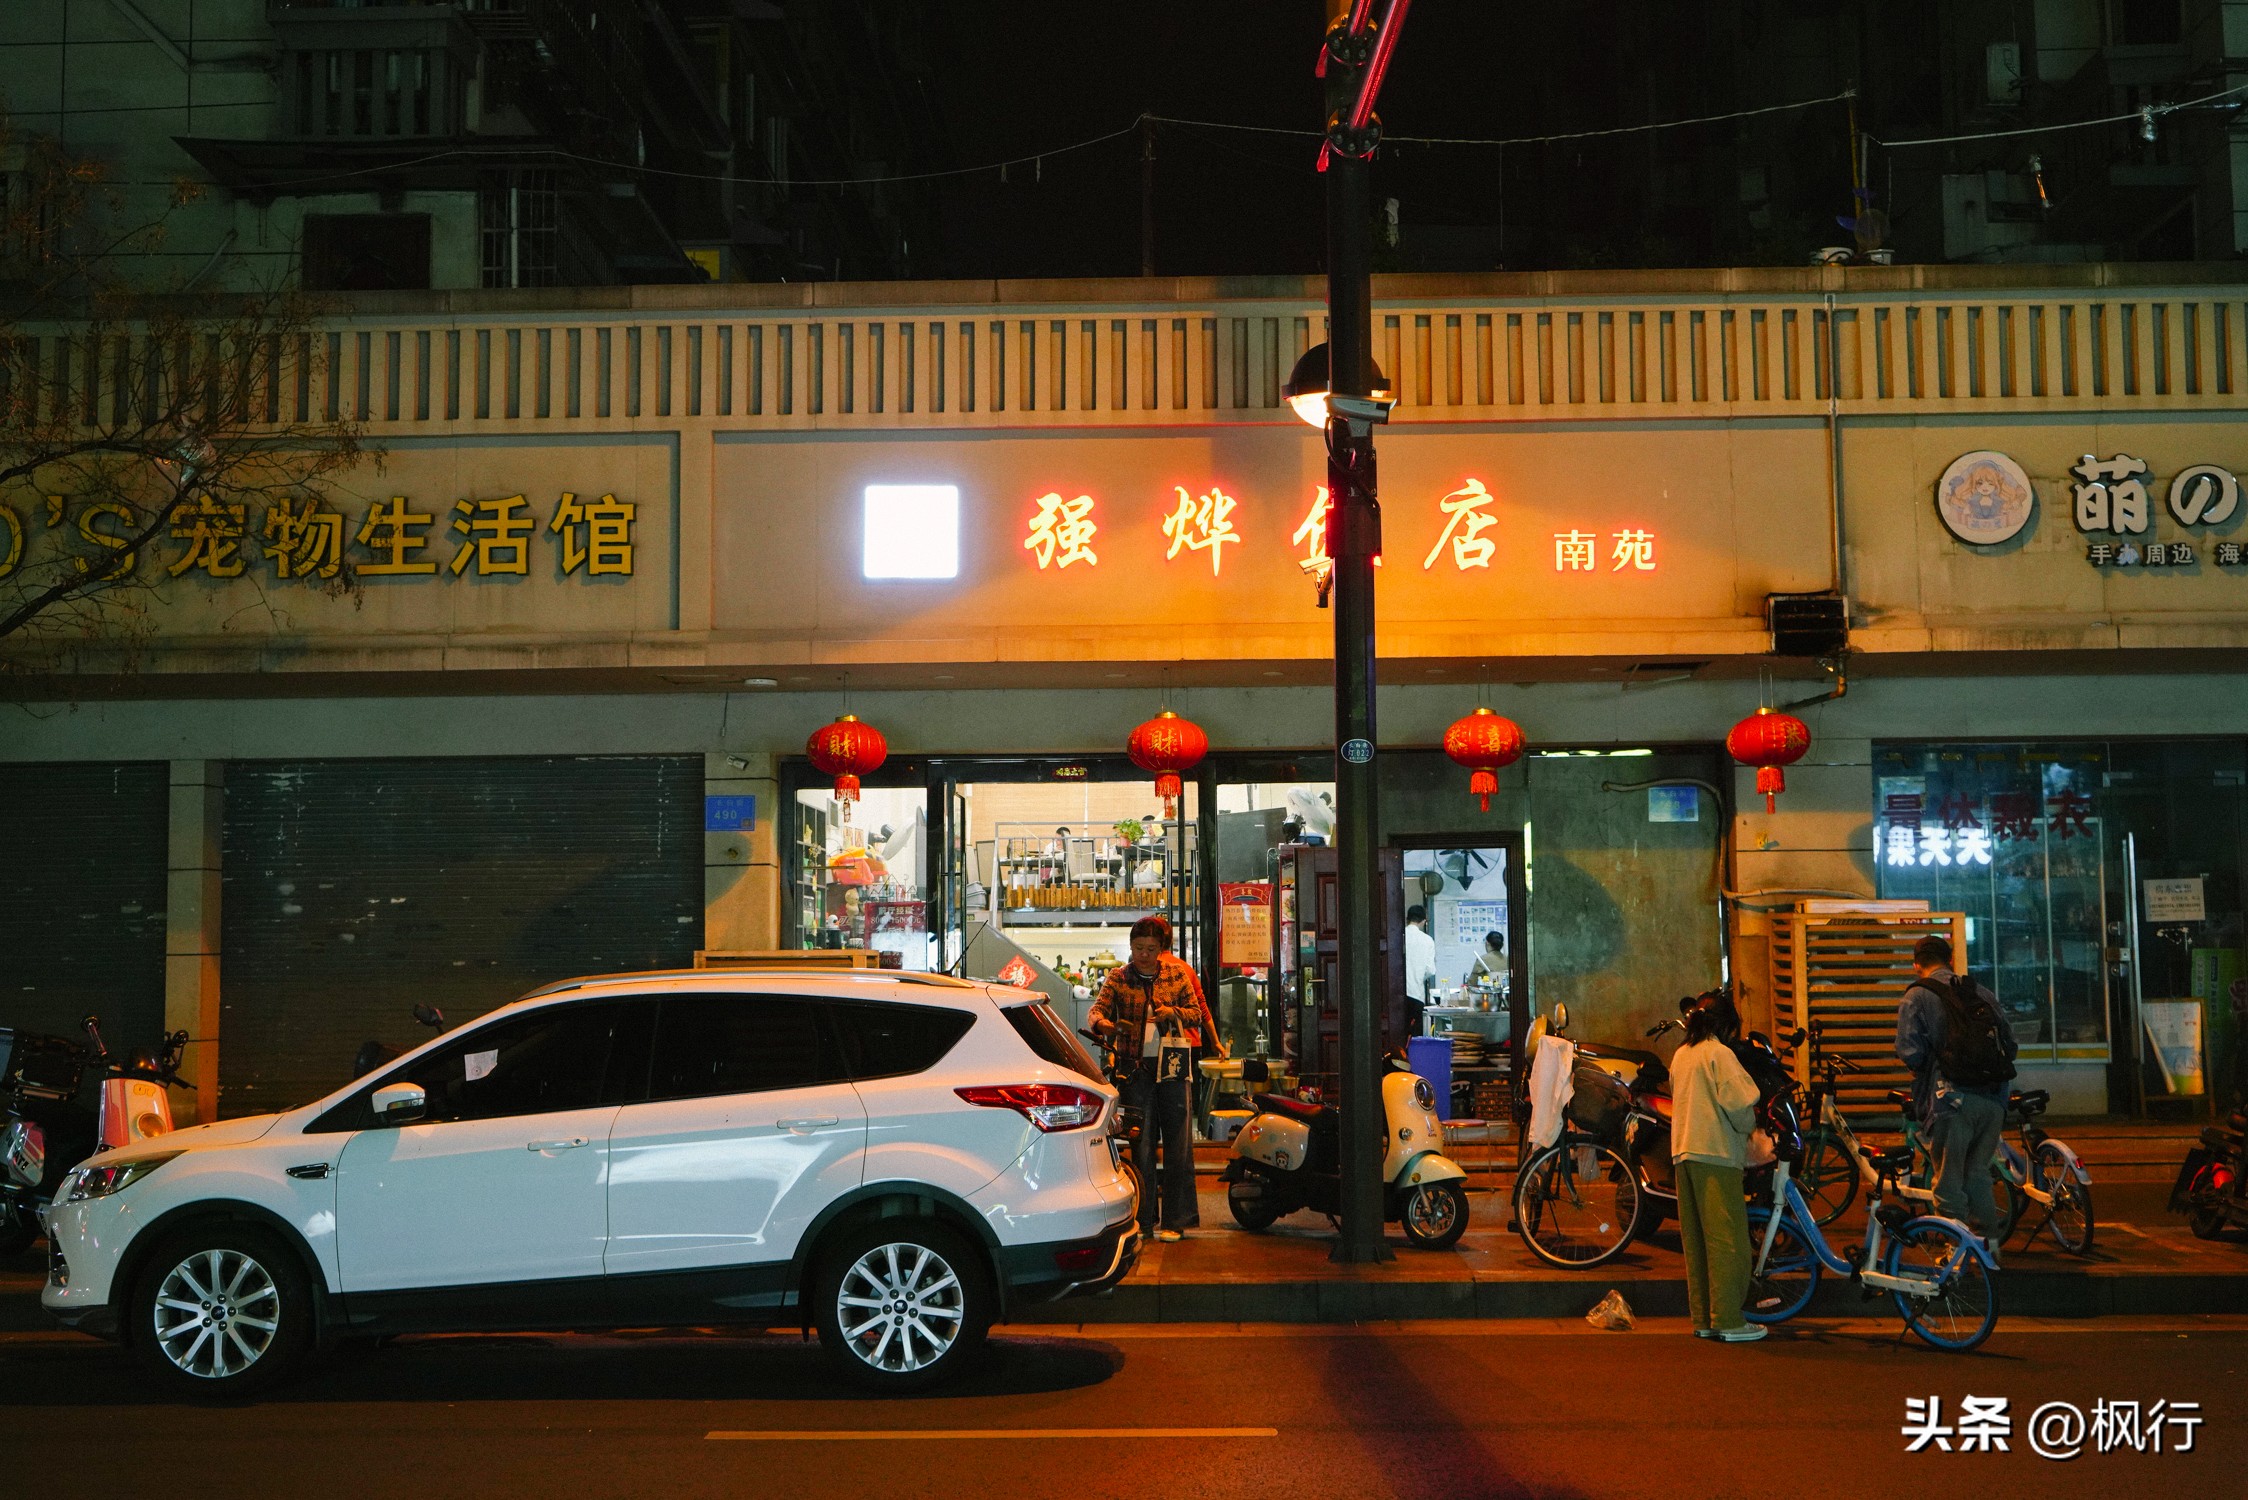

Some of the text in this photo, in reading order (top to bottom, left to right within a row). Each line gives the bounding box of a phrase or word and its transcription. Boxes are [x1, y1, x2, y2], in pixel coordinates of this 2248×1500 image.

[2071, 453, 2239, 534] 萌の
[167, 491, 637, 579] 宠物生活馆
[1024, 478, 1499, 576] 强烨店
[1553, 528, 1657, 572] 南苑
[2089, 543, 2248, 567] 手办周边 海
[713, 809, 738, 820] 490
[1009, 965, 1026, 987] 福
